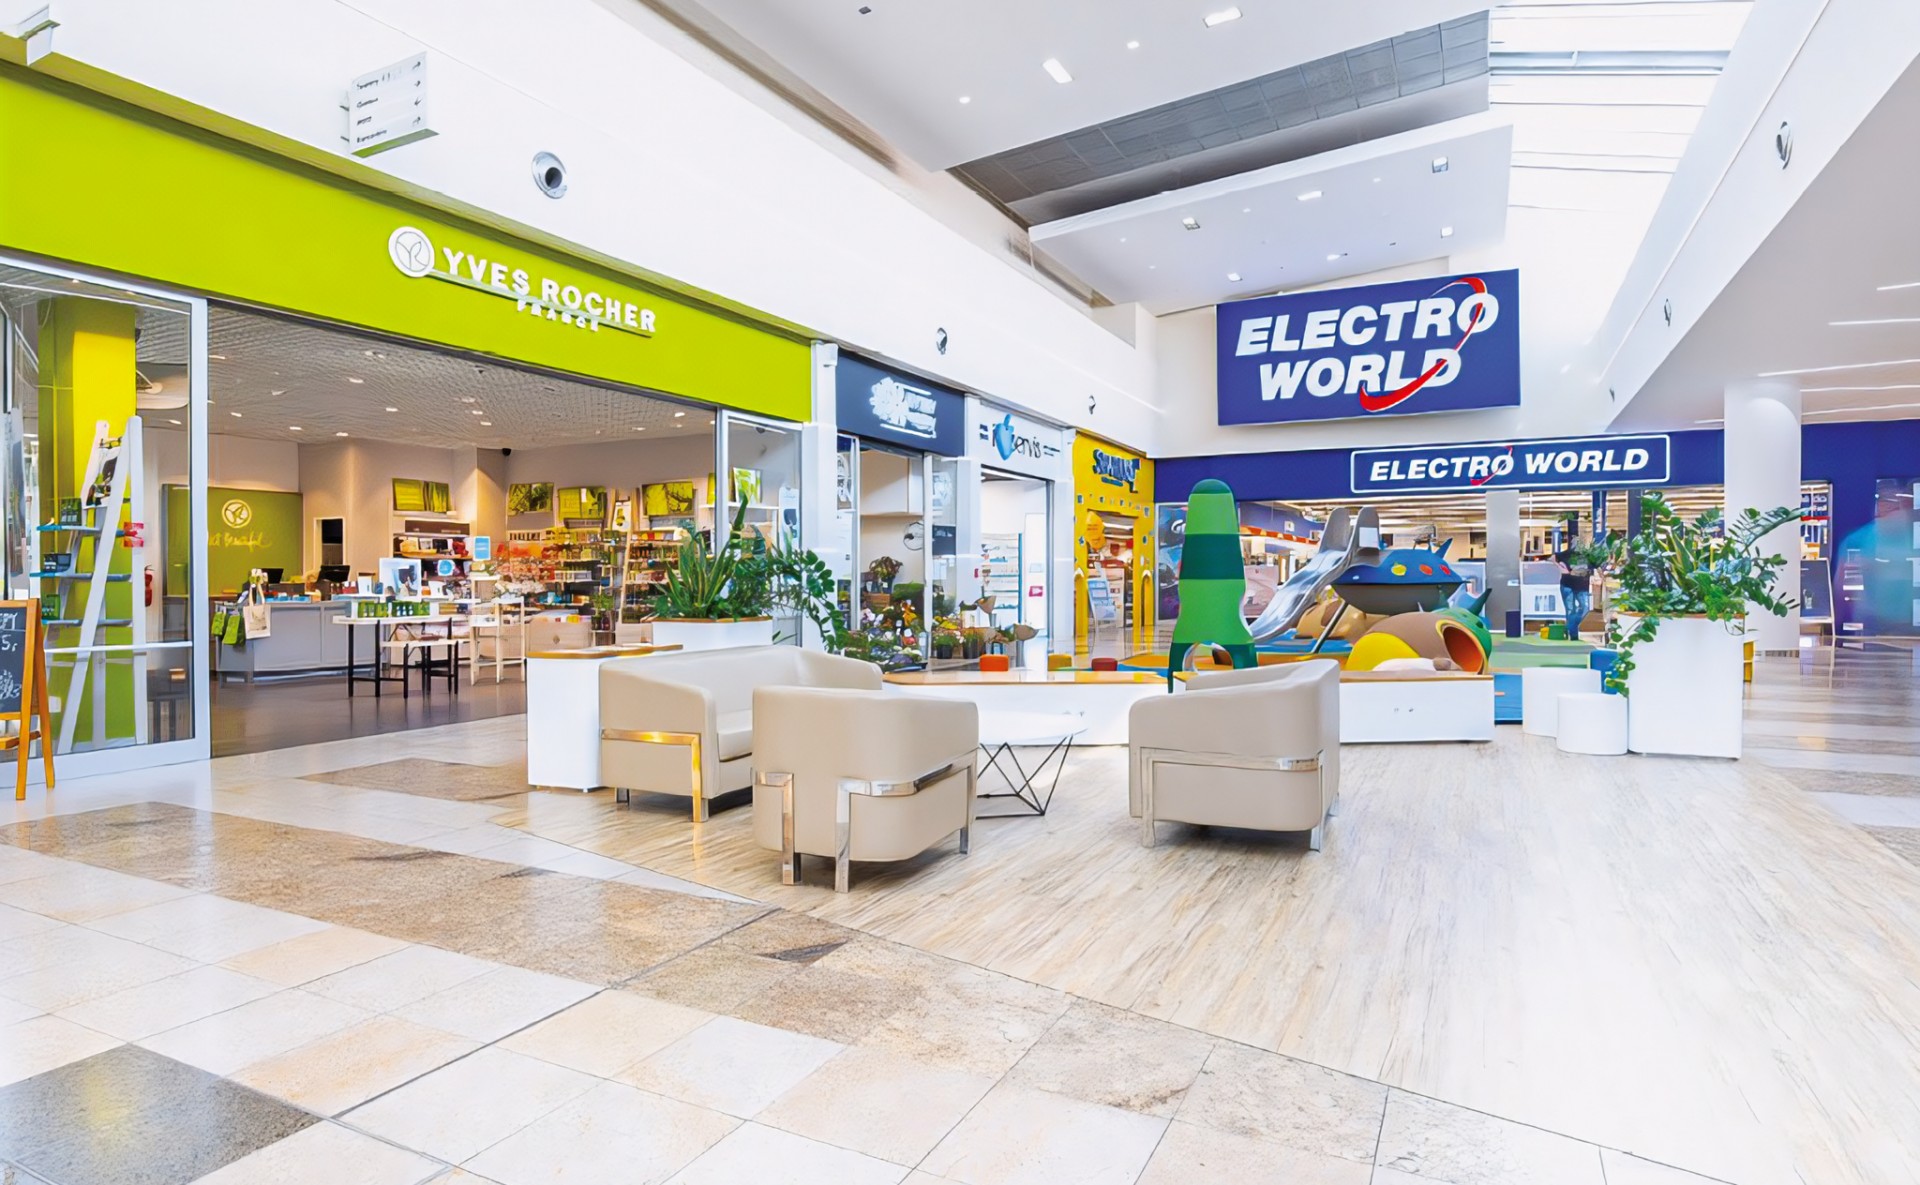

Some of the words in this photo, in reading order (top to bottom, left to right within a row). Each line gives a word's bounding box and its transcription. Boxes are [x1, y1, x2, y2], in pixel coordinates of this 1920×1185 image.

[442, 246, 531, 297] YVES
[541, 277, 657, 333] ROCHER
[1235, 291, 1500, 356] ELECTRO
[1260, 348, 1462, 401] WORLD
[1370, 454, 1515, 482] ELECTRO
[1525, 448, 1650, 476] WORLD
